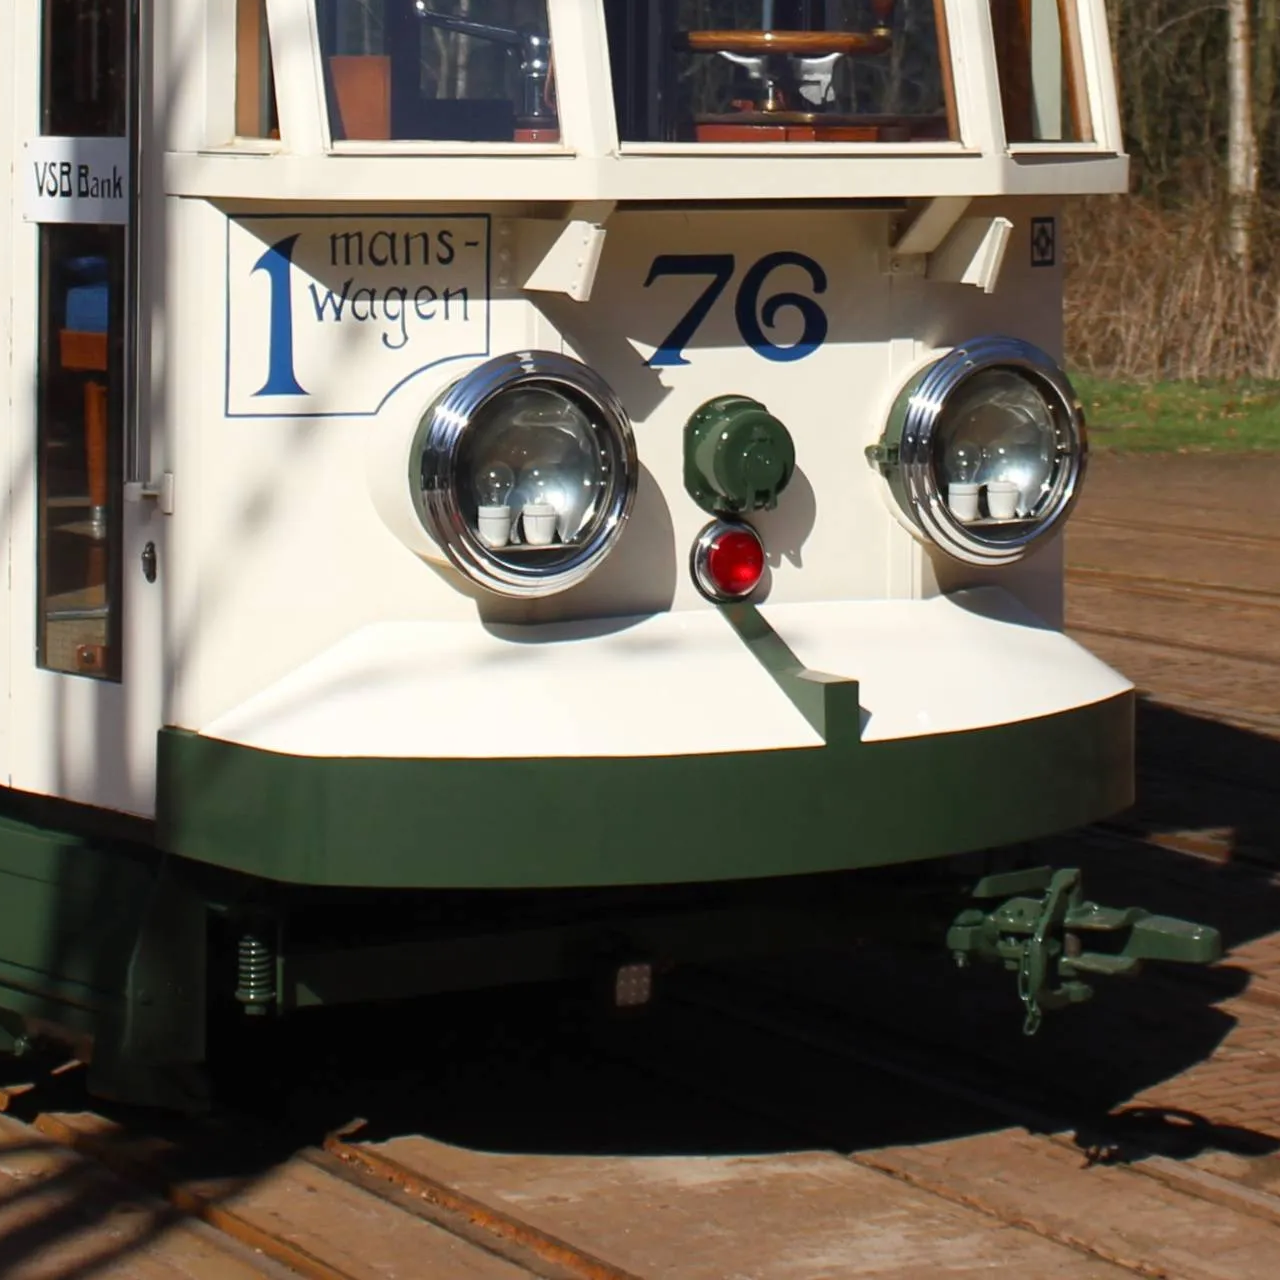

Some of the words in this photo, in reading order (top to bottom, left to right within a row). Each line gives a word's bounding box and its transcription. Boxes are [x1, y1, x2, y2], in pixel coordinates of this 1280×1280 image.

[34, 161, 73, 198] VSB
[77, 163, 124, 199] Bank
[250, 233, 311, 397] 1
[643, 250, 829, 368] 76
